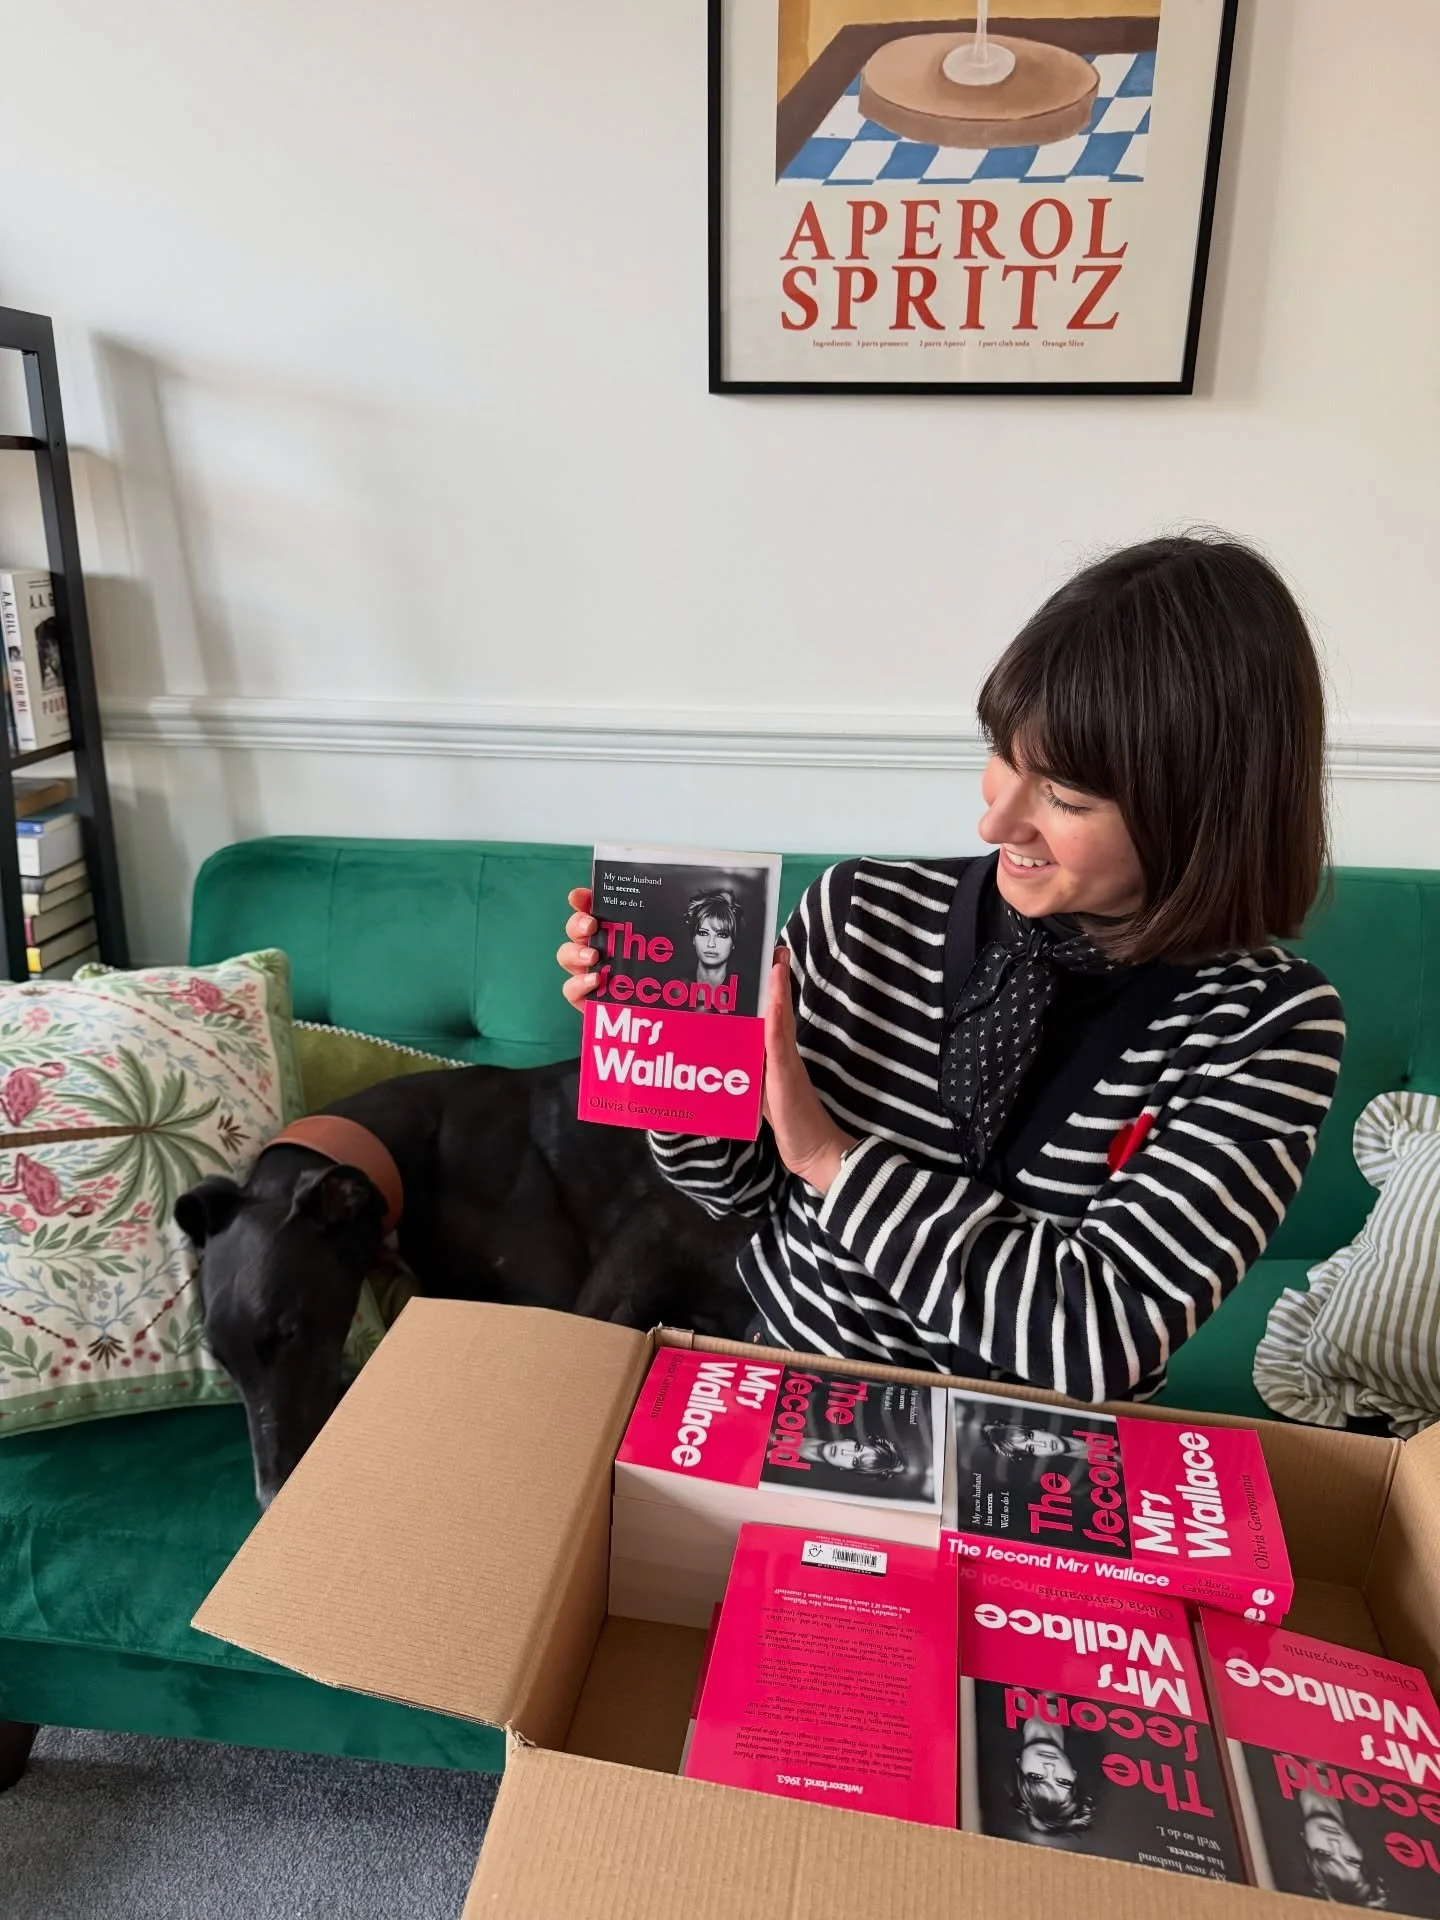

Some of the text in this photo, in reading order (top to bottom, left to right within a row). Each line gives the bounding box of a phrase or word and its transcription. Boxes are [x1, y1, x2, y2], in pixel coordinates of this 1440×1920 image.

[779, 198, 1128, 261] APEROL
[780, 264, 1123, 330] SPRITZ
[943, 339, 966, 348] Aperol
[1042, 339, 1067, 349] Orange
[1068, 339, 1085, 347] Slice
[5, 613, 16, 635] GILL
[12, 669, 28, 713] POUR ME
[603, 882, 641, 894] has secrets.
[604, 872, 616, 882] My
[632, 875, 662, 885] husband
[603, 896, 618, 905] Well
[600, 921, 674, 963] The
[596, 965, 738, 1014] Second
[595, 1005, 663, 1045] Mrs
[593, 1045, 750, 1095] Wallace
[589, 1096, 695, 1121] Olivia Gavoyannis
[736, 1365, 780, 1410] Mrs
[825, 1380, 868, 1425] The
[671, 1362, 738, 1468] Wallace
[768, 1371, 812, 1470] Second
[972, 1472, 982, 1498] husband
[1001, 1496, 1009, 1505] do
[1028, 1472, 1073, 1534] The
[1073, 1430, 1125, 1549] Second
[1175, 1431, 1232, 1558] Wallace
[972, 1512, 983, 1525] My
[984, 1515, 993, 1527] has
[1001, 1513, 1009, 1528] Well
[1003, 1505, 1009, 1513] so
[1135, 1489, 1179, 1555] Mrs
[1242, 1473, 1271, 1570] Olivia Gavoyannis
[948, 1538, 1170, 1587] The Second Mrs Wallace
[1038, 1586, 1173, 1620] Olivia Gavoyannis
[1197, 1578, 1230, 1591] Olivia
[974, 1603, 1184, 1672] Wallace
[1098, 1662, 1192, 1717] Mrs
[1282, 1644, 1419, 1692] Olivia Gavoyannis
[1003, 1687, 1199, 1763] Second
[1225, 1658, 1440, 1750] Wallace
[1361, 1734, 1440, 1785] Mrs
[775, 1773, 863, 1794] Switzerland, 1963.
[1101, 1752, 1216, 1818] The
[1273, 1753, 1440, 1825] econd
[1167, 1828, 1181, 1840] do
[1183, 1833, 1195, 1841] so
[1197, 1836, 1221, 1851] Well
[1138, 1852, 1183, 1873] husband
[1166, 1845, 1225, 1870] has secrets.
[1184, 1863, 1206, 1875] new
